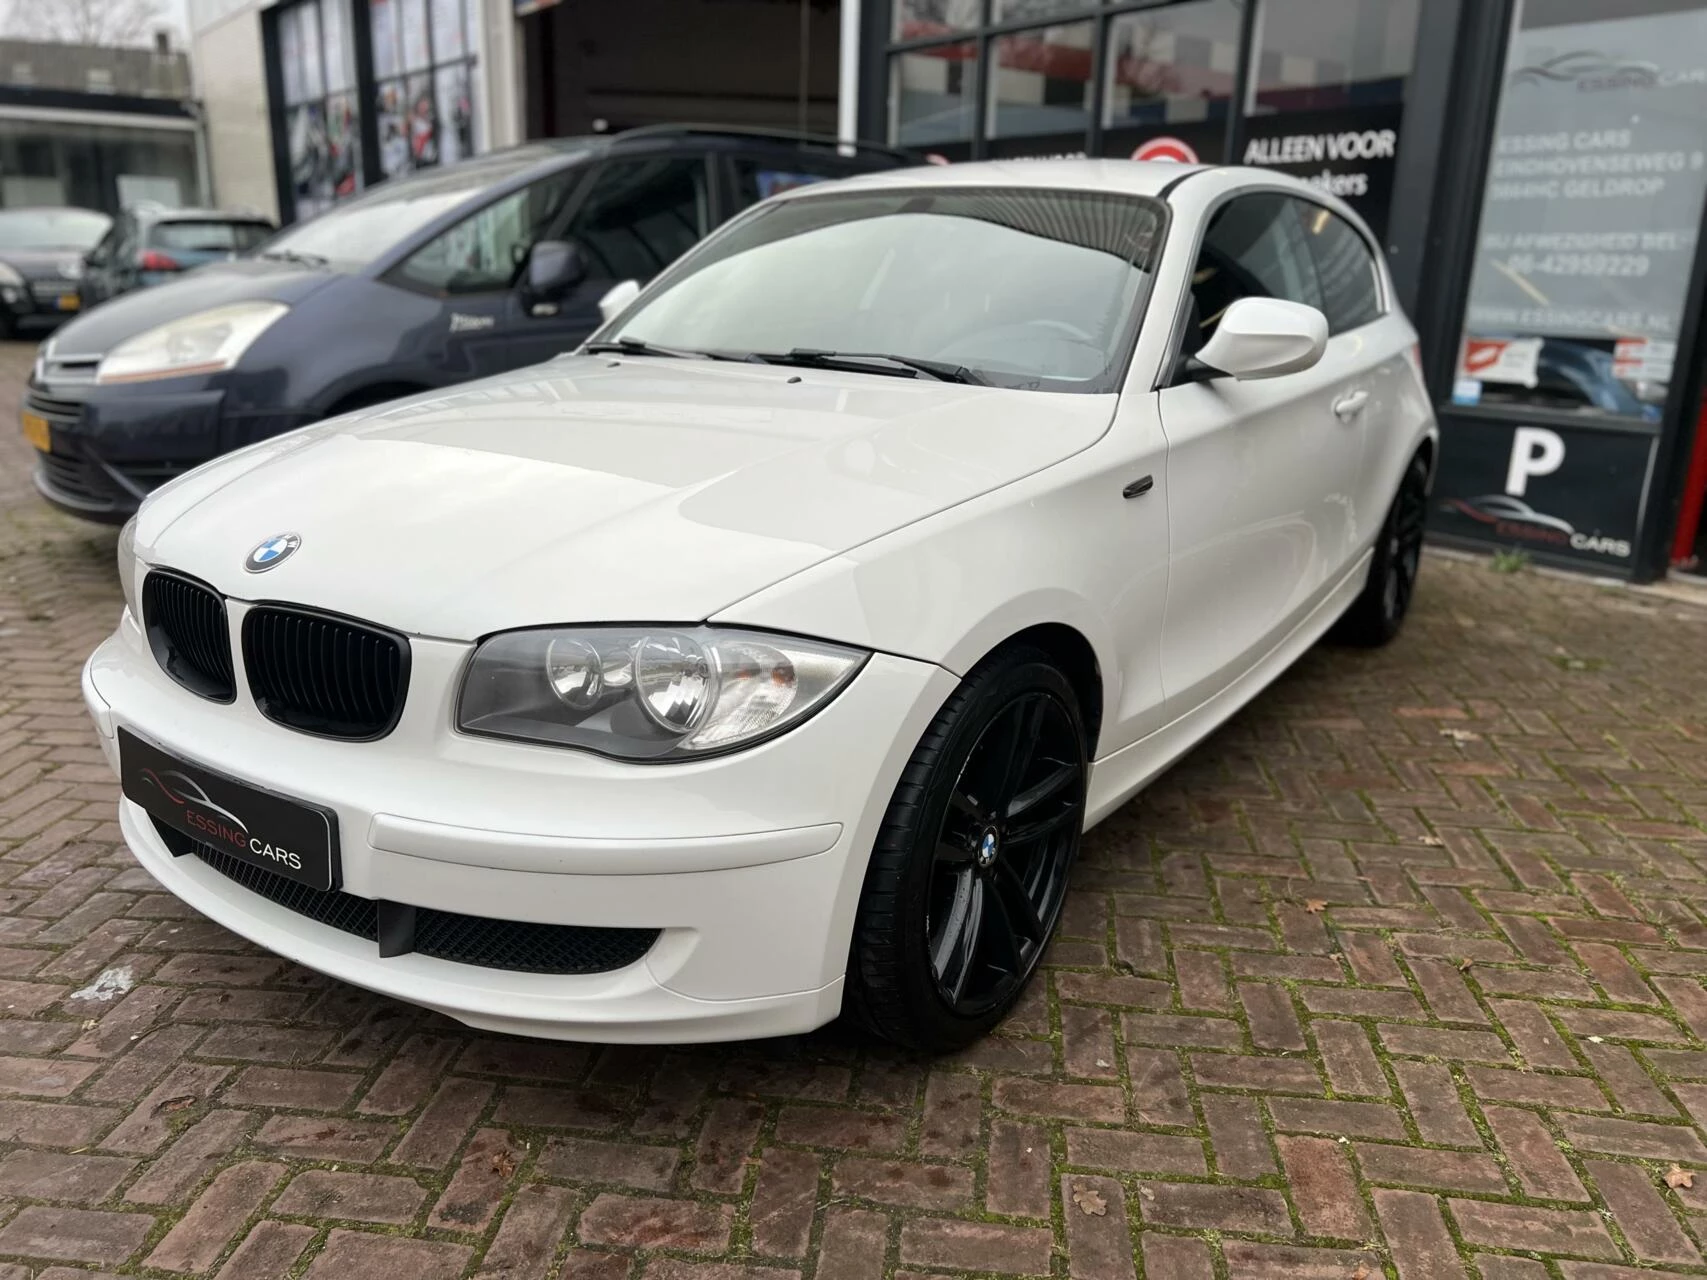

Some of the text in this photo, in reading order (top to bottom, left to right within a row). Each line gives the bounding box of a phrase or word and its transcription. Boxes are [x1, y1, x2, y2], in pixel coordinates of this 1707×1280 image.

[1243, 129, 1396, 165] ALLEEN VOOR
[1573, 129, 1632, 150] CARS
[1505, 427, 1566, 497] P
[1570, 533, 1632, 558] CARS
[186, 809, 302, 870] ESSING CARS
